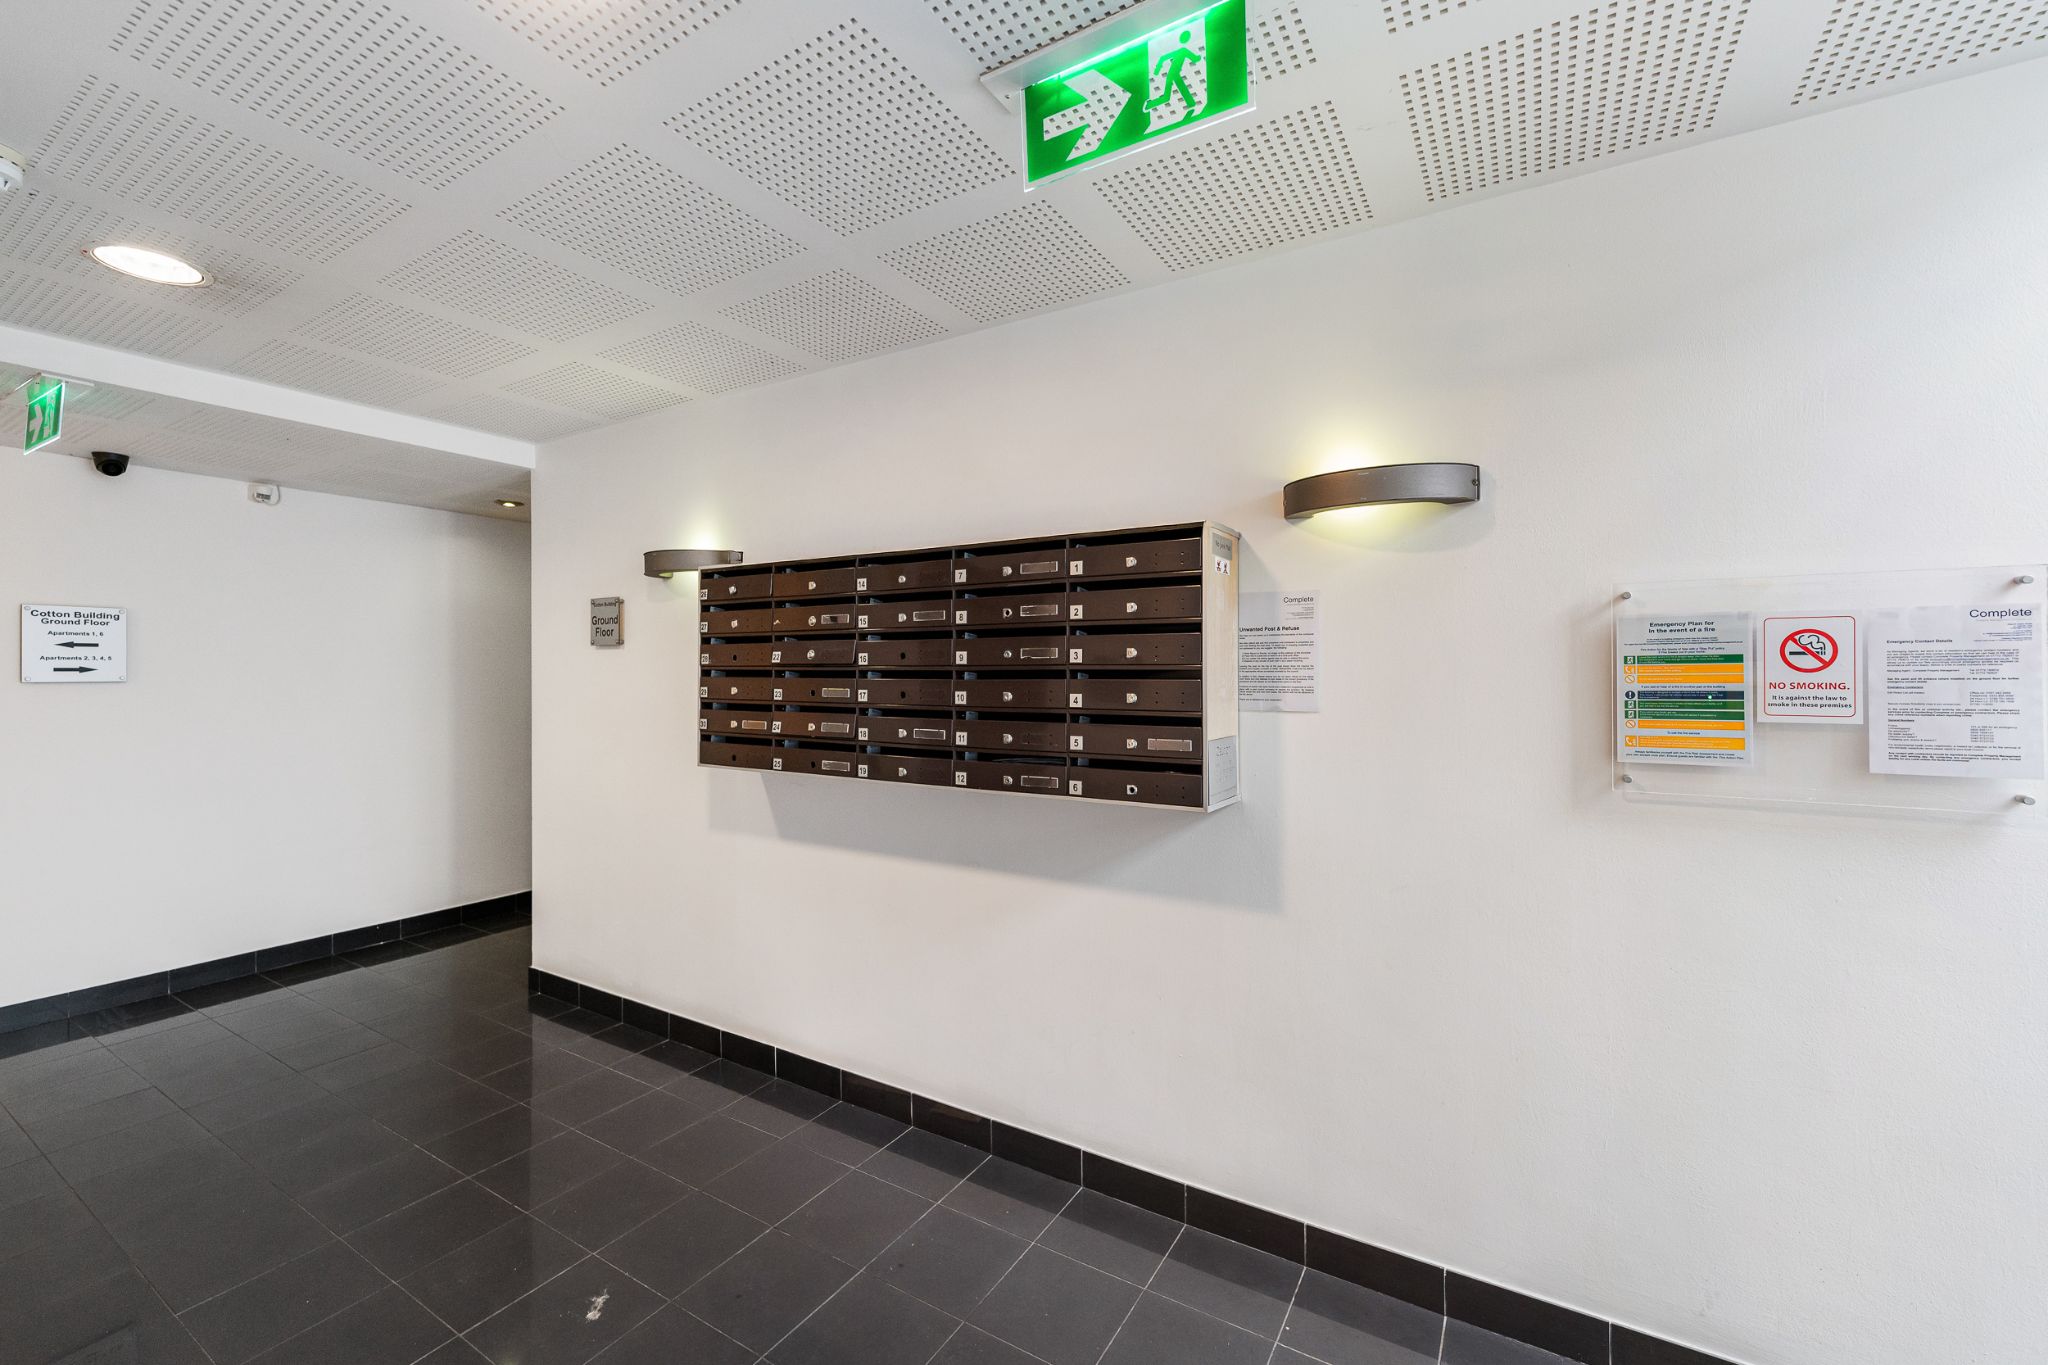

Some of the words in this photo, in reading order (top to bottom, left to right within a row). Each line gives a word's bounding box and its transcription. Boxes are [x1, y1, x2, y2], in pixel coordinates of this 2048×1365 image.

[1283, 596, 1314, 604] Complete
[30, 609, 70, 618] Cotton
[74, 611, 120, 621] Building
[1969, 608, 2032, 619] Complete
[41, 617, 80, 625] Ground
[592, 615, 618, 625] Ground
[595, 627, 614, 637] Floor
[1769, 682, 1786, 690] NO
[1789, 682, 1850, 690] SMOKING.
